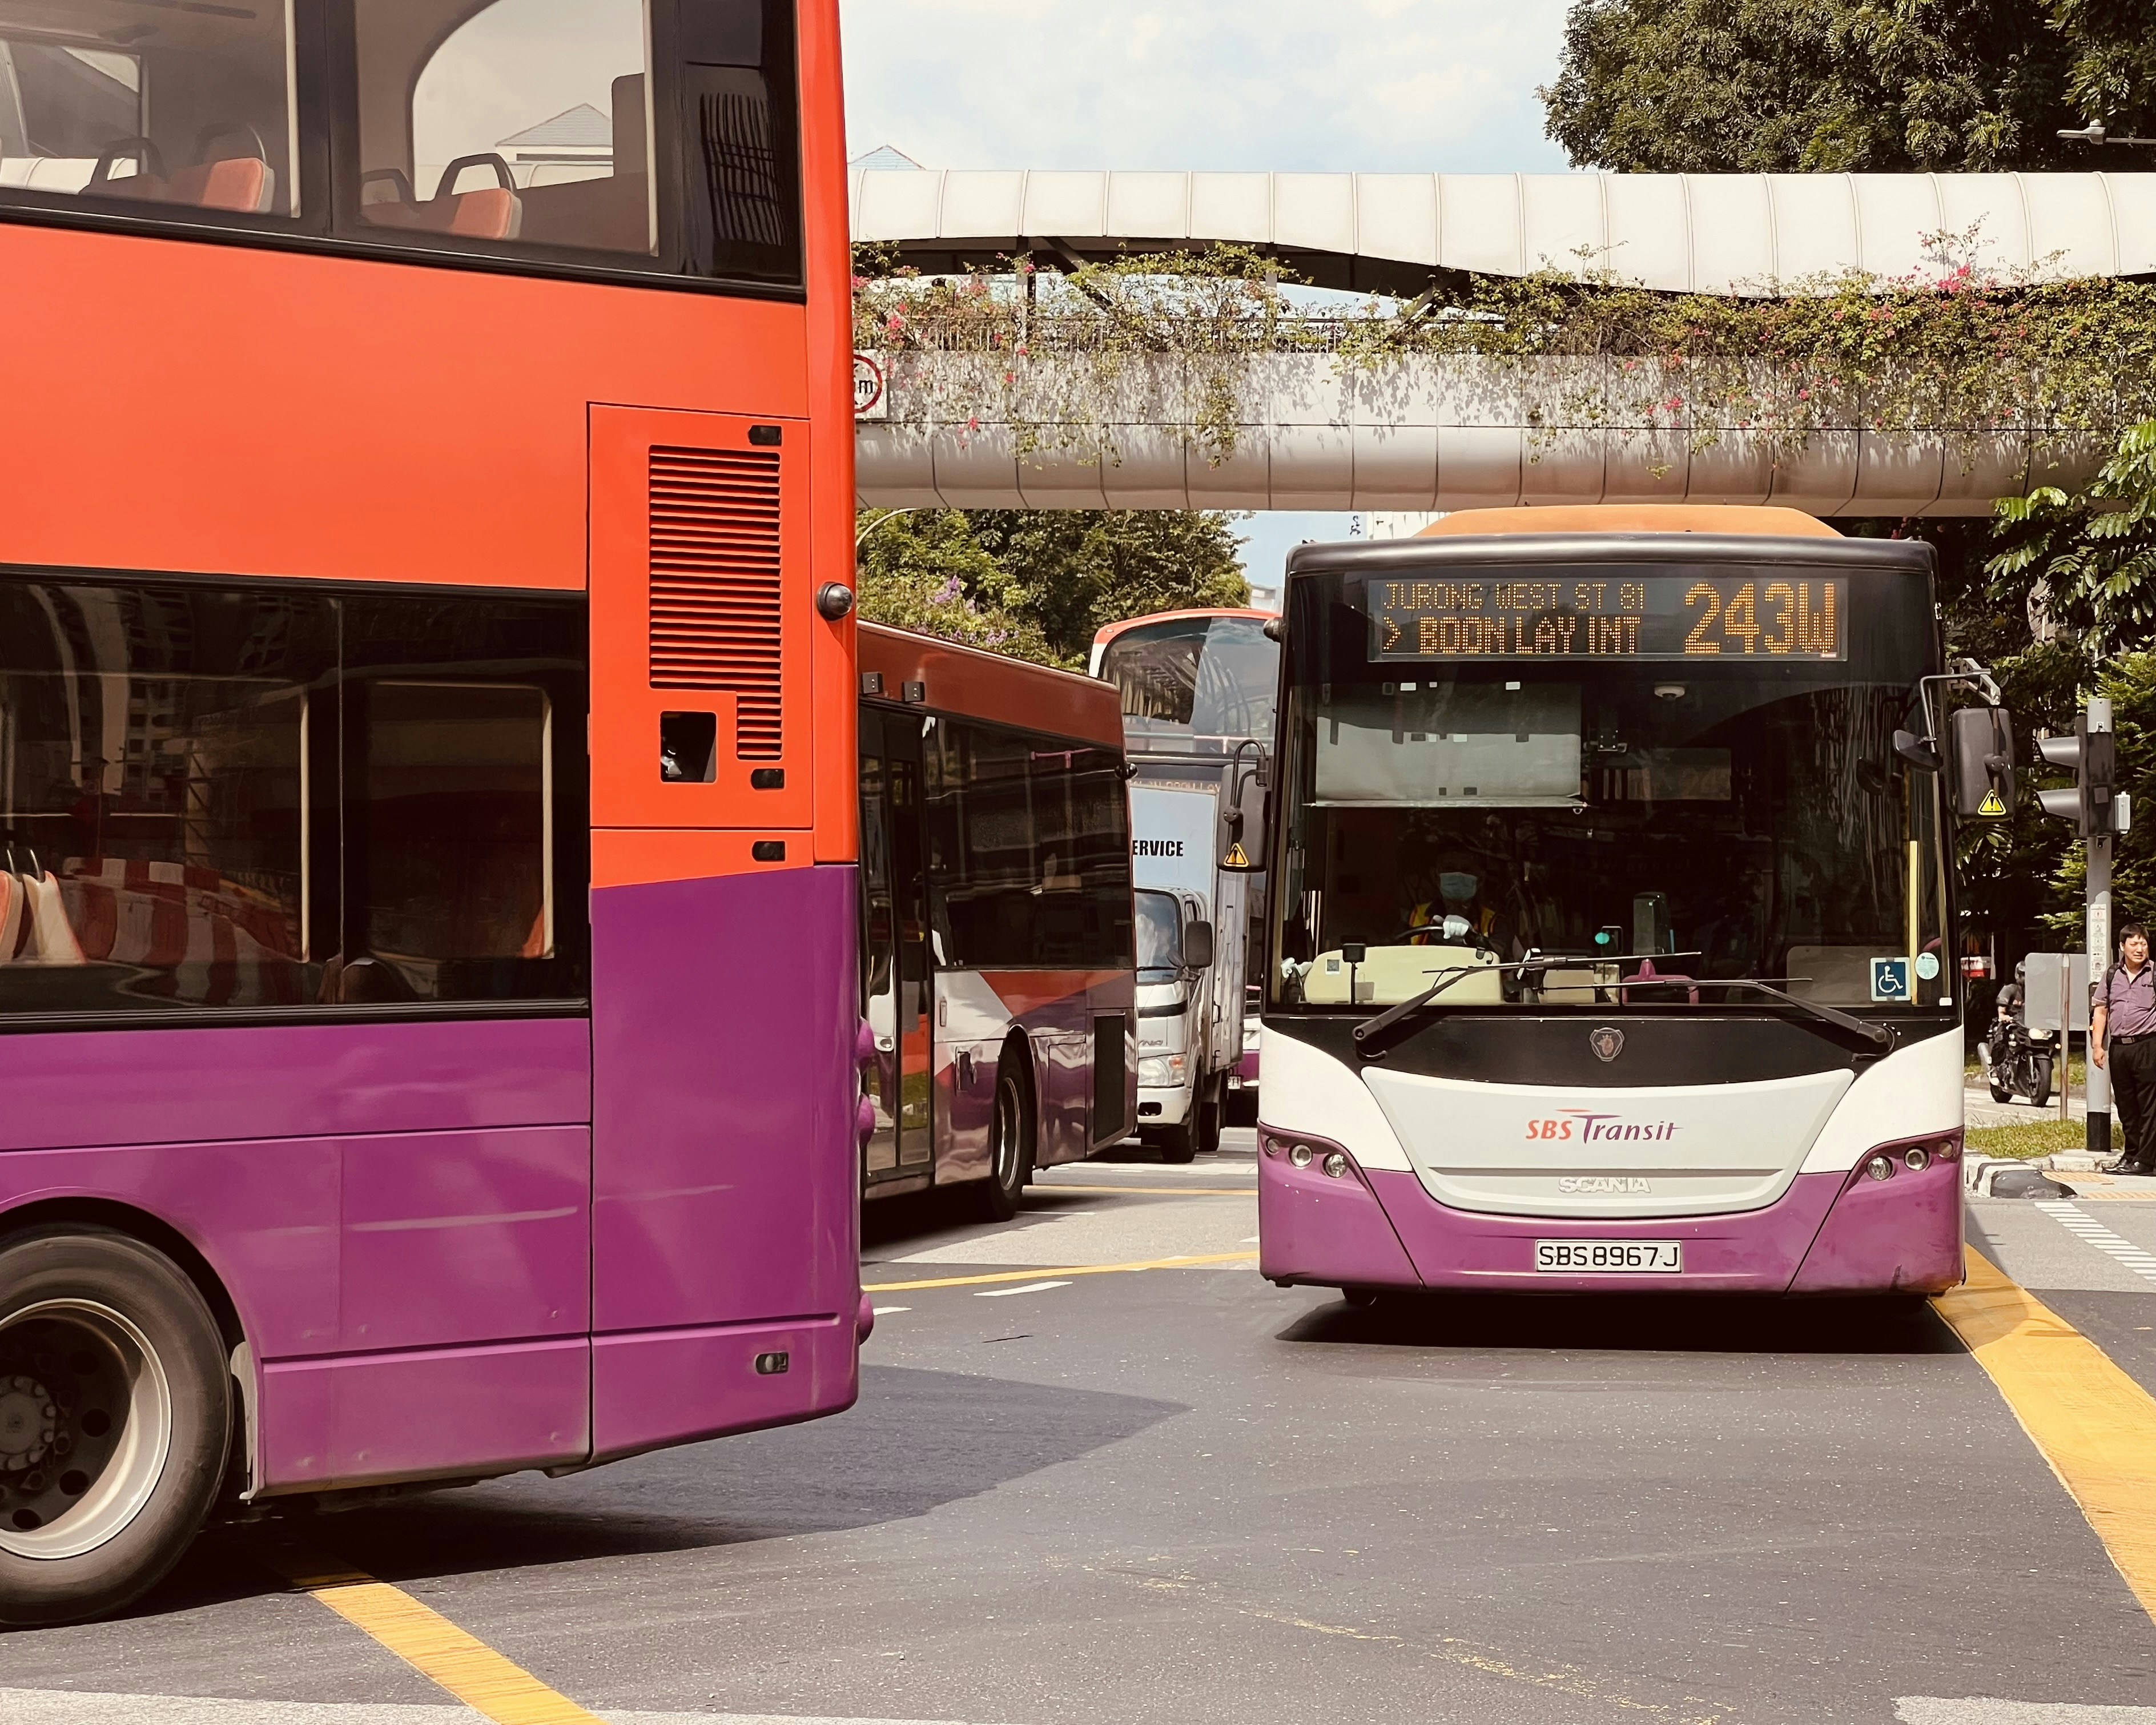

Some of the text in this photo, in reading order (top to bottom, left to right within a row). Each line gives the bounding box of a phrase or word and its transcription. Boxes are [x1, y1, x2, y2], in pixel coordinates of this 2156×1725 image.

[1383, 583, 1644, 609] JURONG WEST ST 81
[1684, 583, 1835, 654] 243W
[1418, 616, 1641, 654] BOON LAY INT
[1132, 840, 1184, 857] ERVICE
[1526, 1115, 1684, 1144] SBS Transit
[1558, 1177, 1651, 1193] SCANIA
[1539, 1246, 1678, 1266] SBS8967J
